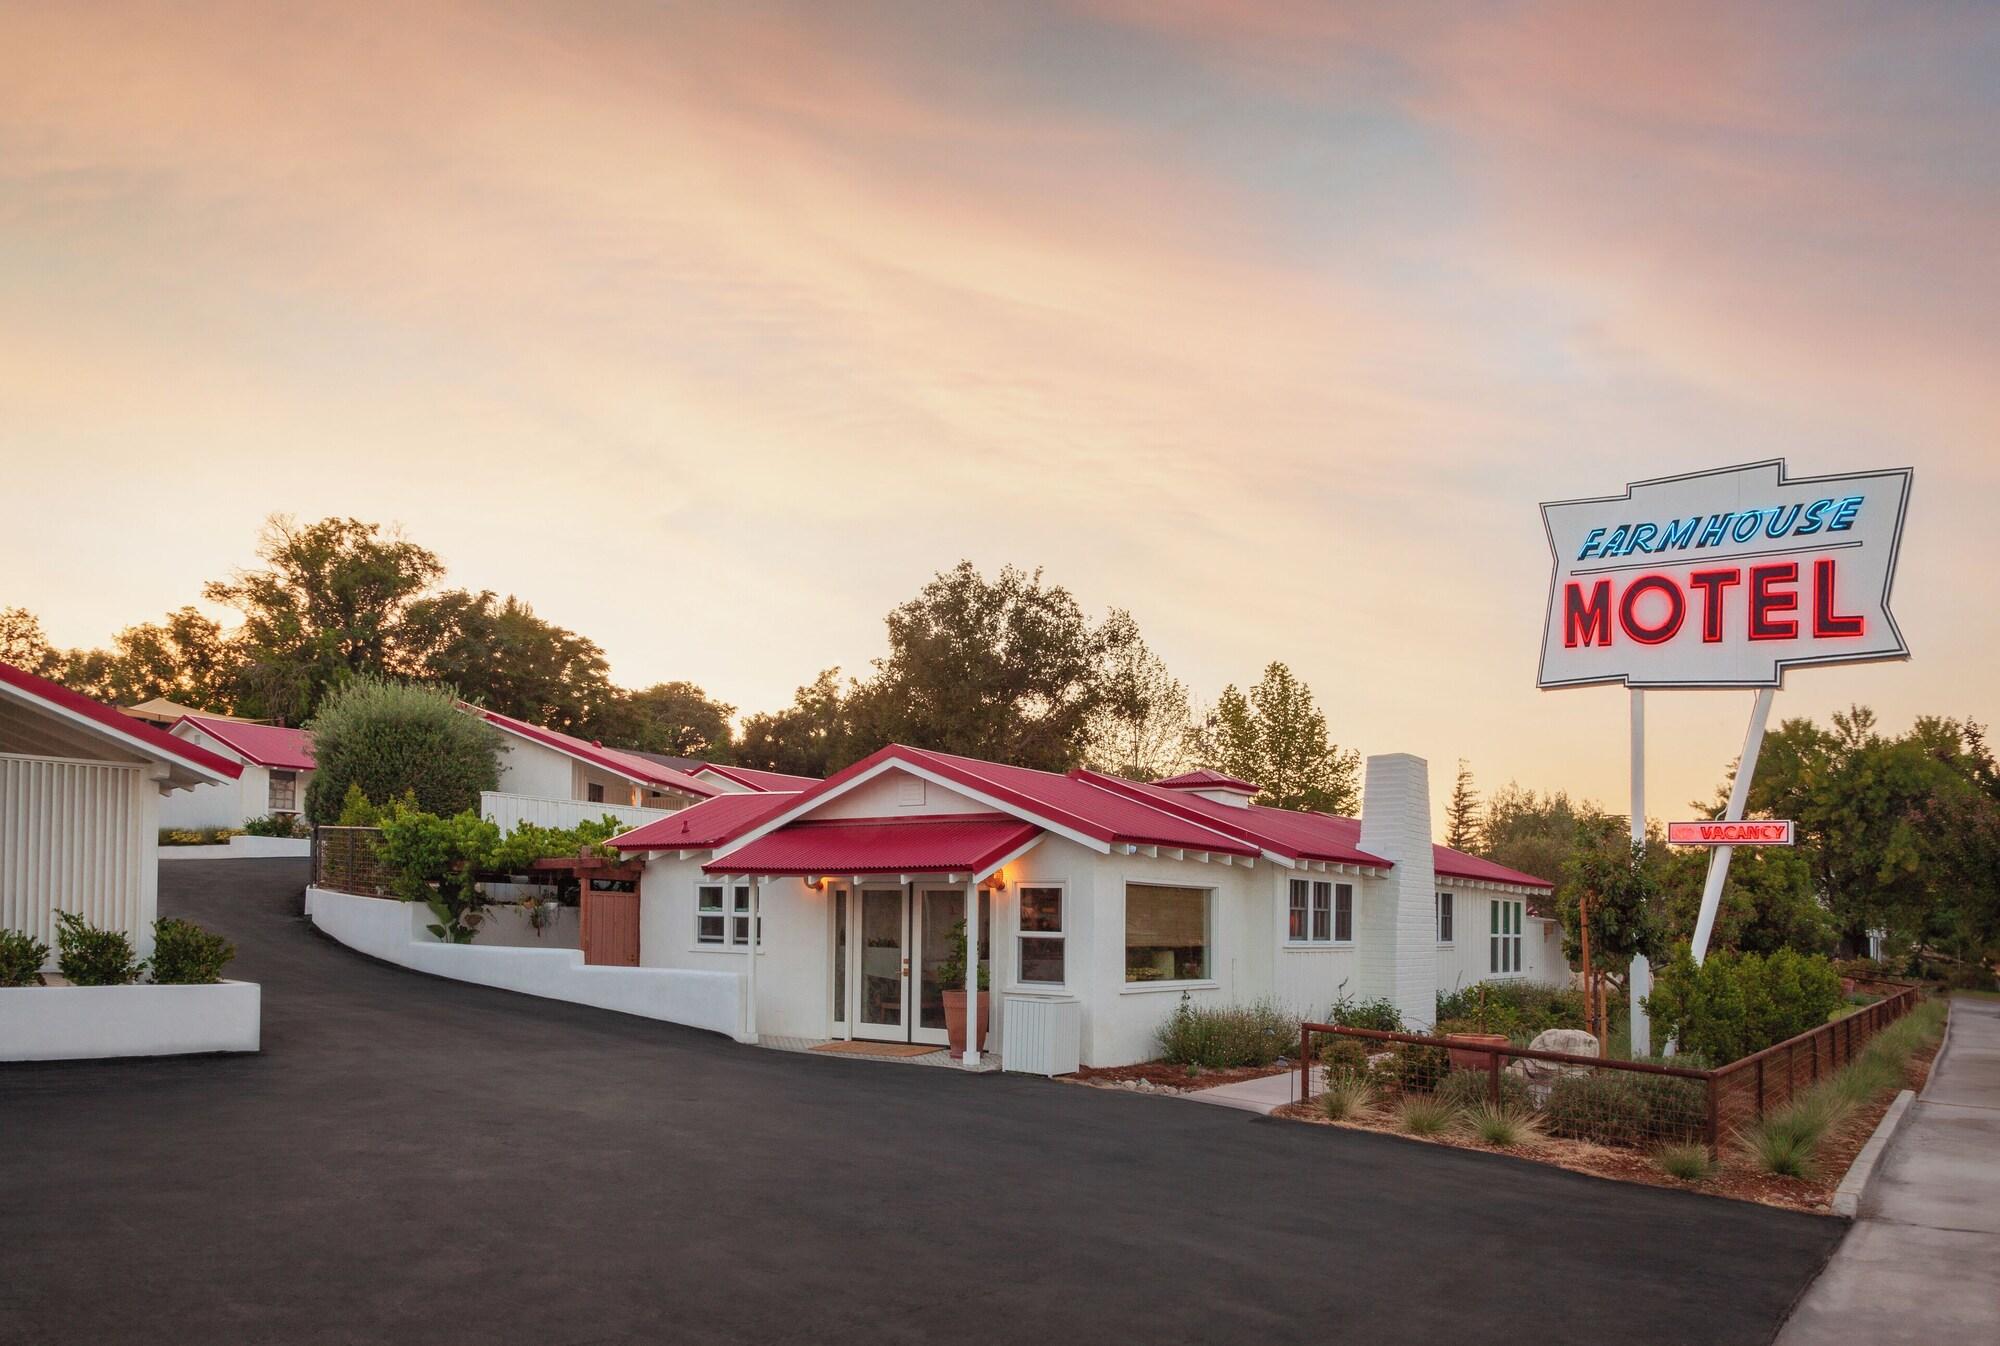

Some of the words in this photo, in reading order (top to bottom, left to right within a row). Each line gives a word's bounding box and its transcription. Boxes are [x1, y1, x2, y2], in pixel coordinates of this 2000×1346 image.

[1577, 496, 1865, 561] FARMHOUSE
[1564, 559, 1865, 648] MOTEL
[1700, 825, 1785, 840] VACANCY
